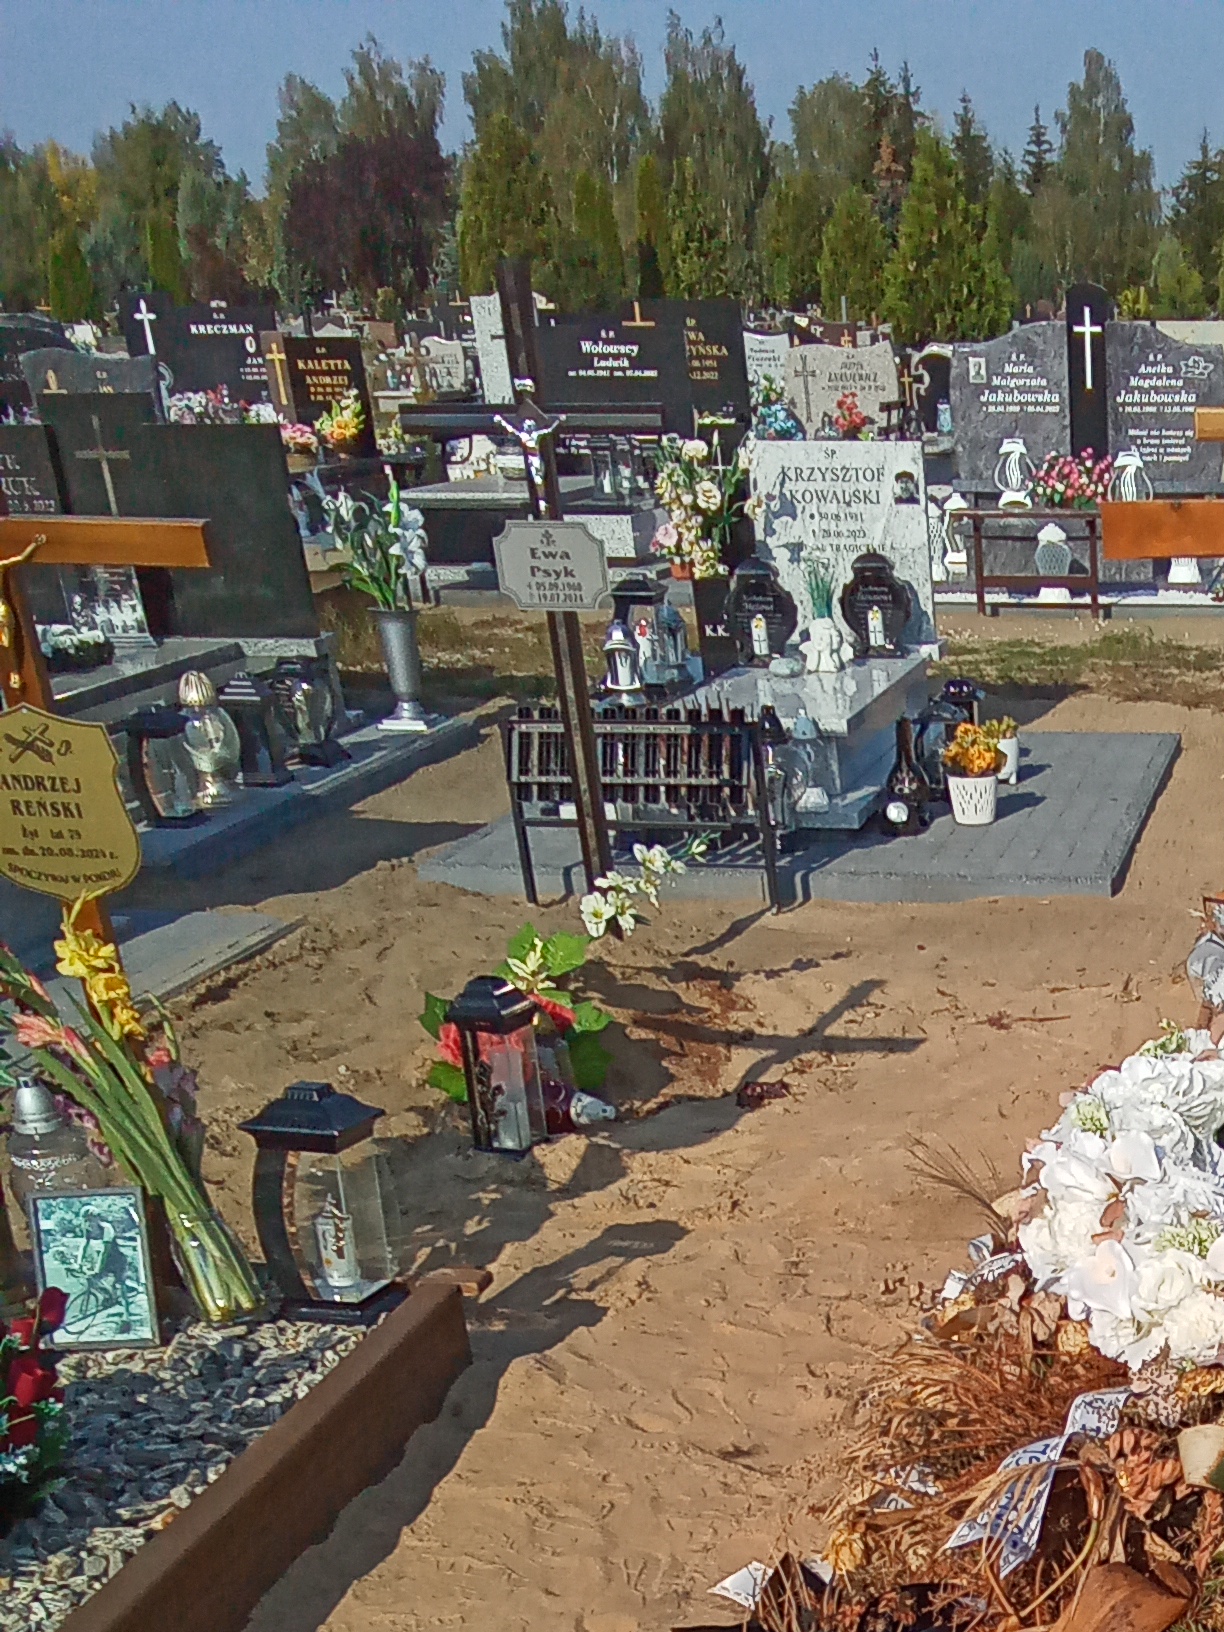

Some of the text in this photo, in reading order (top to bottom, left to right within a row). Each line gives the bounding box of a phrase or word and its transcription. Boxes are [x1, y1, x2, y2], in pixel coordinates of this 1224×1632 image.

[190, 323, 254, 334] KRECZMAN
[297, 359, 351, 370] KALETTA
[1004, 362, 1034, 374] Maria
[305, 375, 348, 385] ANDRZEJ
[1129, 375, 1184, 388] Magdalena
[980, 389, 1060, 402] Jakubowska
[1116, 389, 1197, 403] Jakubowska
[781, 466, 885, 483] KRZYSZTOF
[787, 489, 881, 505] KOWALSKI
[529, 547, 571, 560] Ewa
[529, 565, 576, 581] Psyk
[0, 773, 82, 794] ANDRZEJ
[10, 797, 83, 819] REŃSKI
